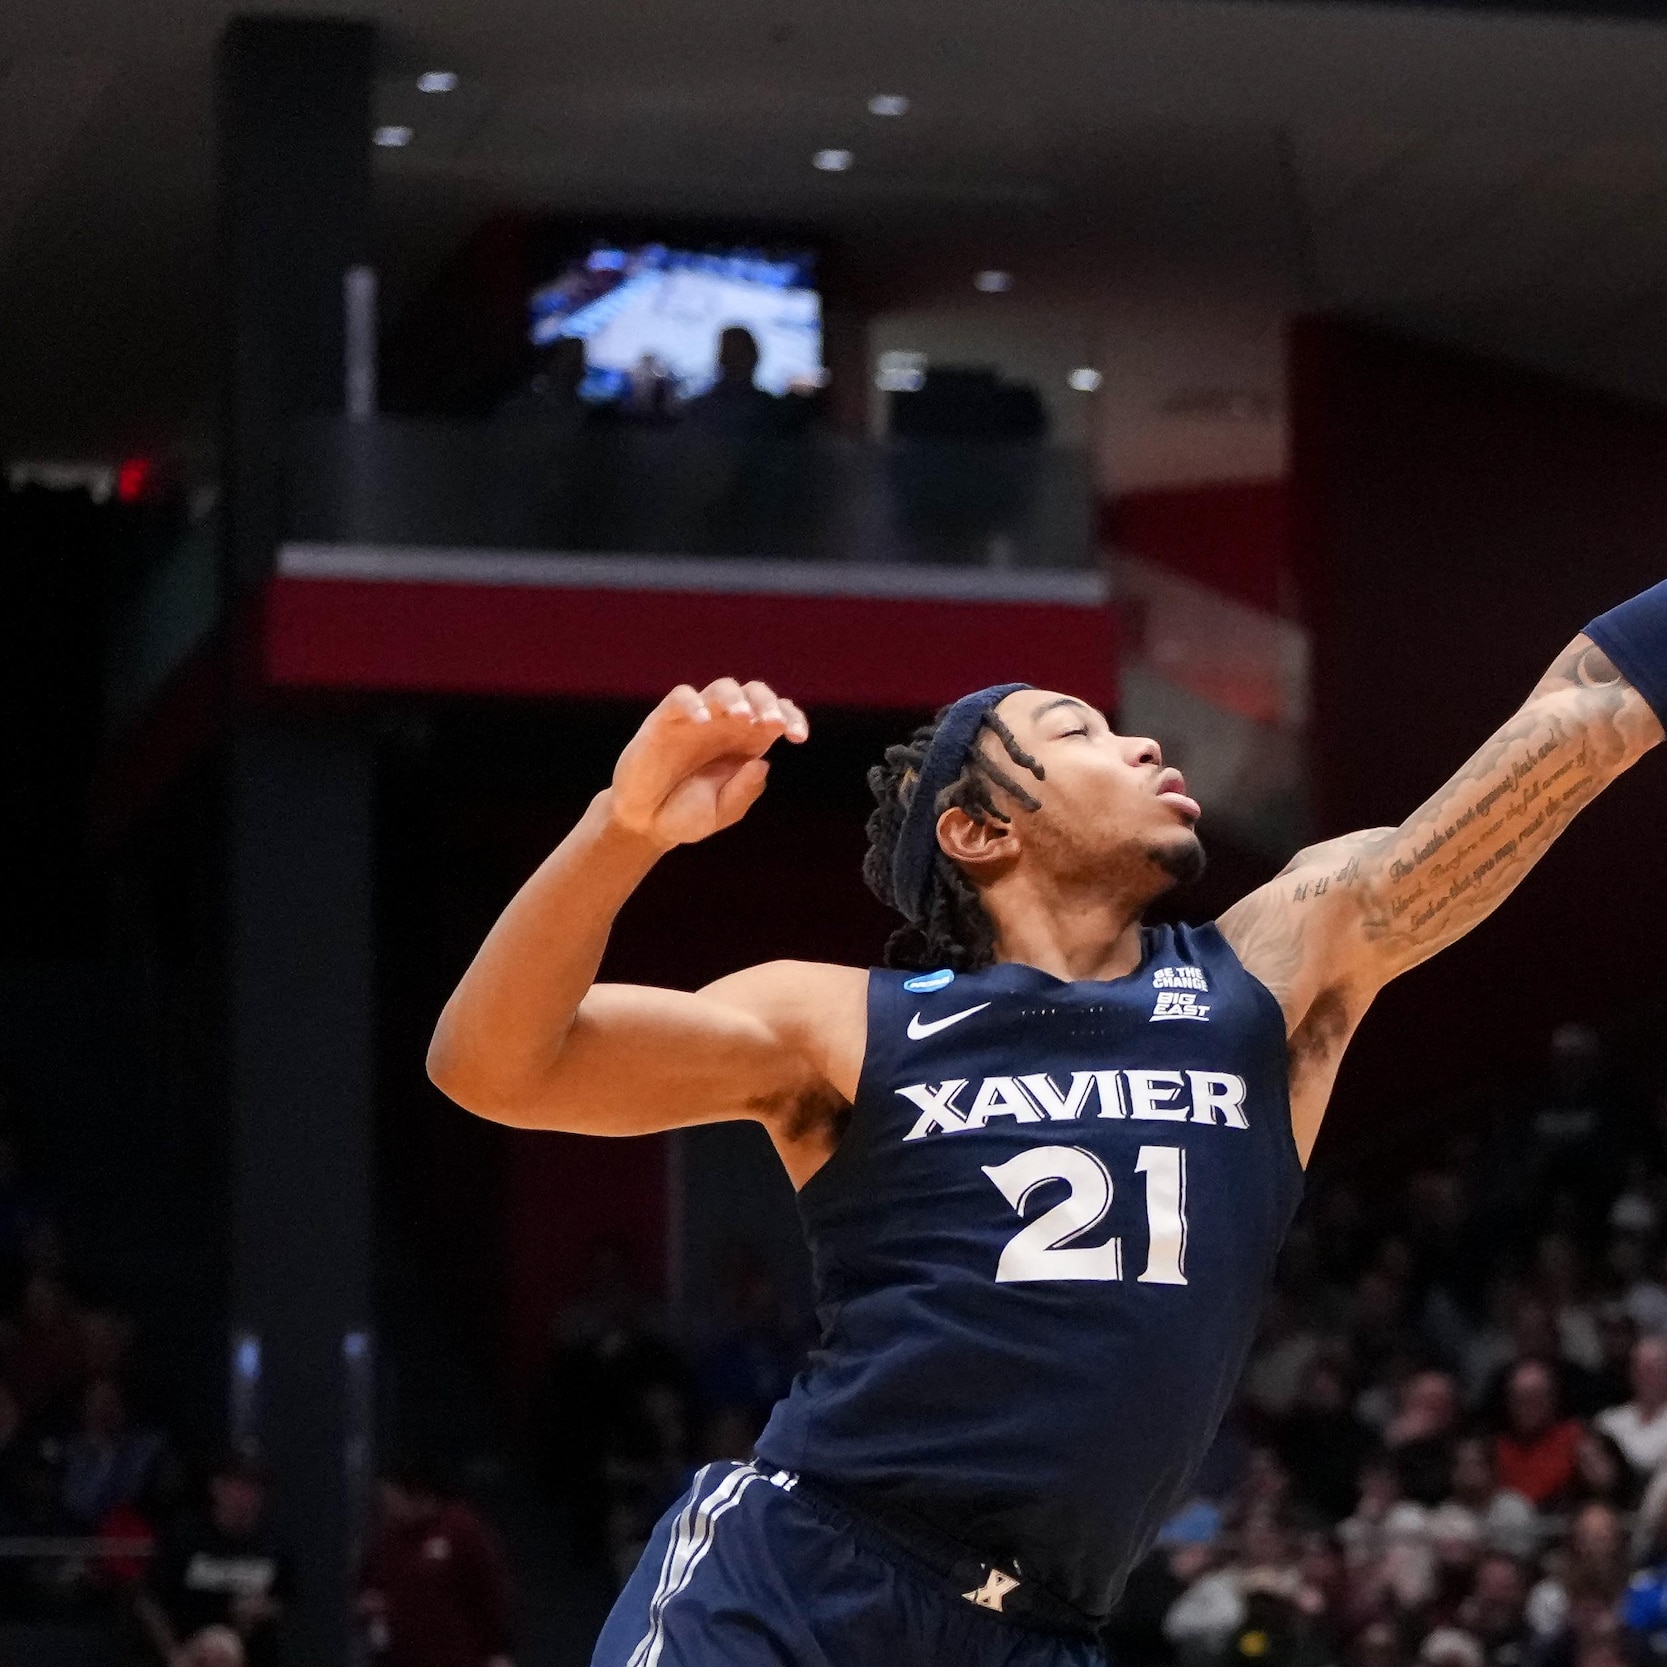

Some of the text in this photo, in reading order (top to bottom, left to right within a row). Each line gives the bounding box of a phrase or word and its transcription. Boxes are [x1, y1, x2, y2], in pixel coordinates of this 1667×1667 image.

[1153, 966, 1203, 980] BE THE
[1152, 976, 1209, 993] CHANGE
[1156, 990, 1197, 1005] BIG
[1152, 1003, 1211, 1017] EAST
[894, 1068, 1250, 1142] XAVIER
[981, 1144, 1189, 1286] 21
